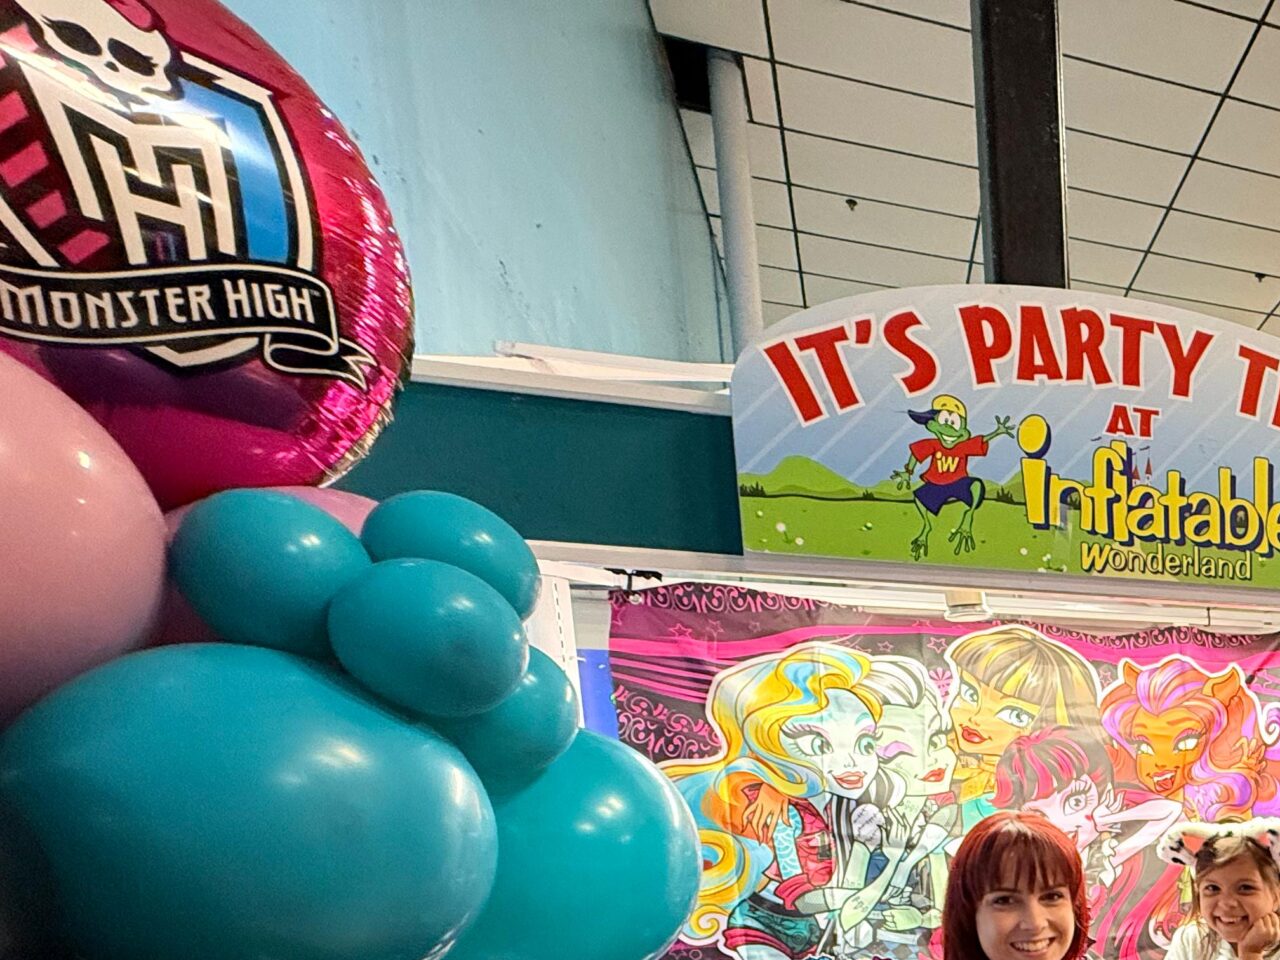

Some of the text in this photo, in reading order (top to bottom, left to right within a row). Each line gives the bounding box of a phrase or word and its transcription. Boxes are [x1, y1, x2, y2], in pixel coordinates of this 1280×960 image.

[0, 281, 216, 331] MONSTER
[222, 278, 316, 324] HIGH
[764, 311, 935, 422] IT'S
[959, 305, 1213, 397] PARTY
[1105, 404, 1160, 437] AT
